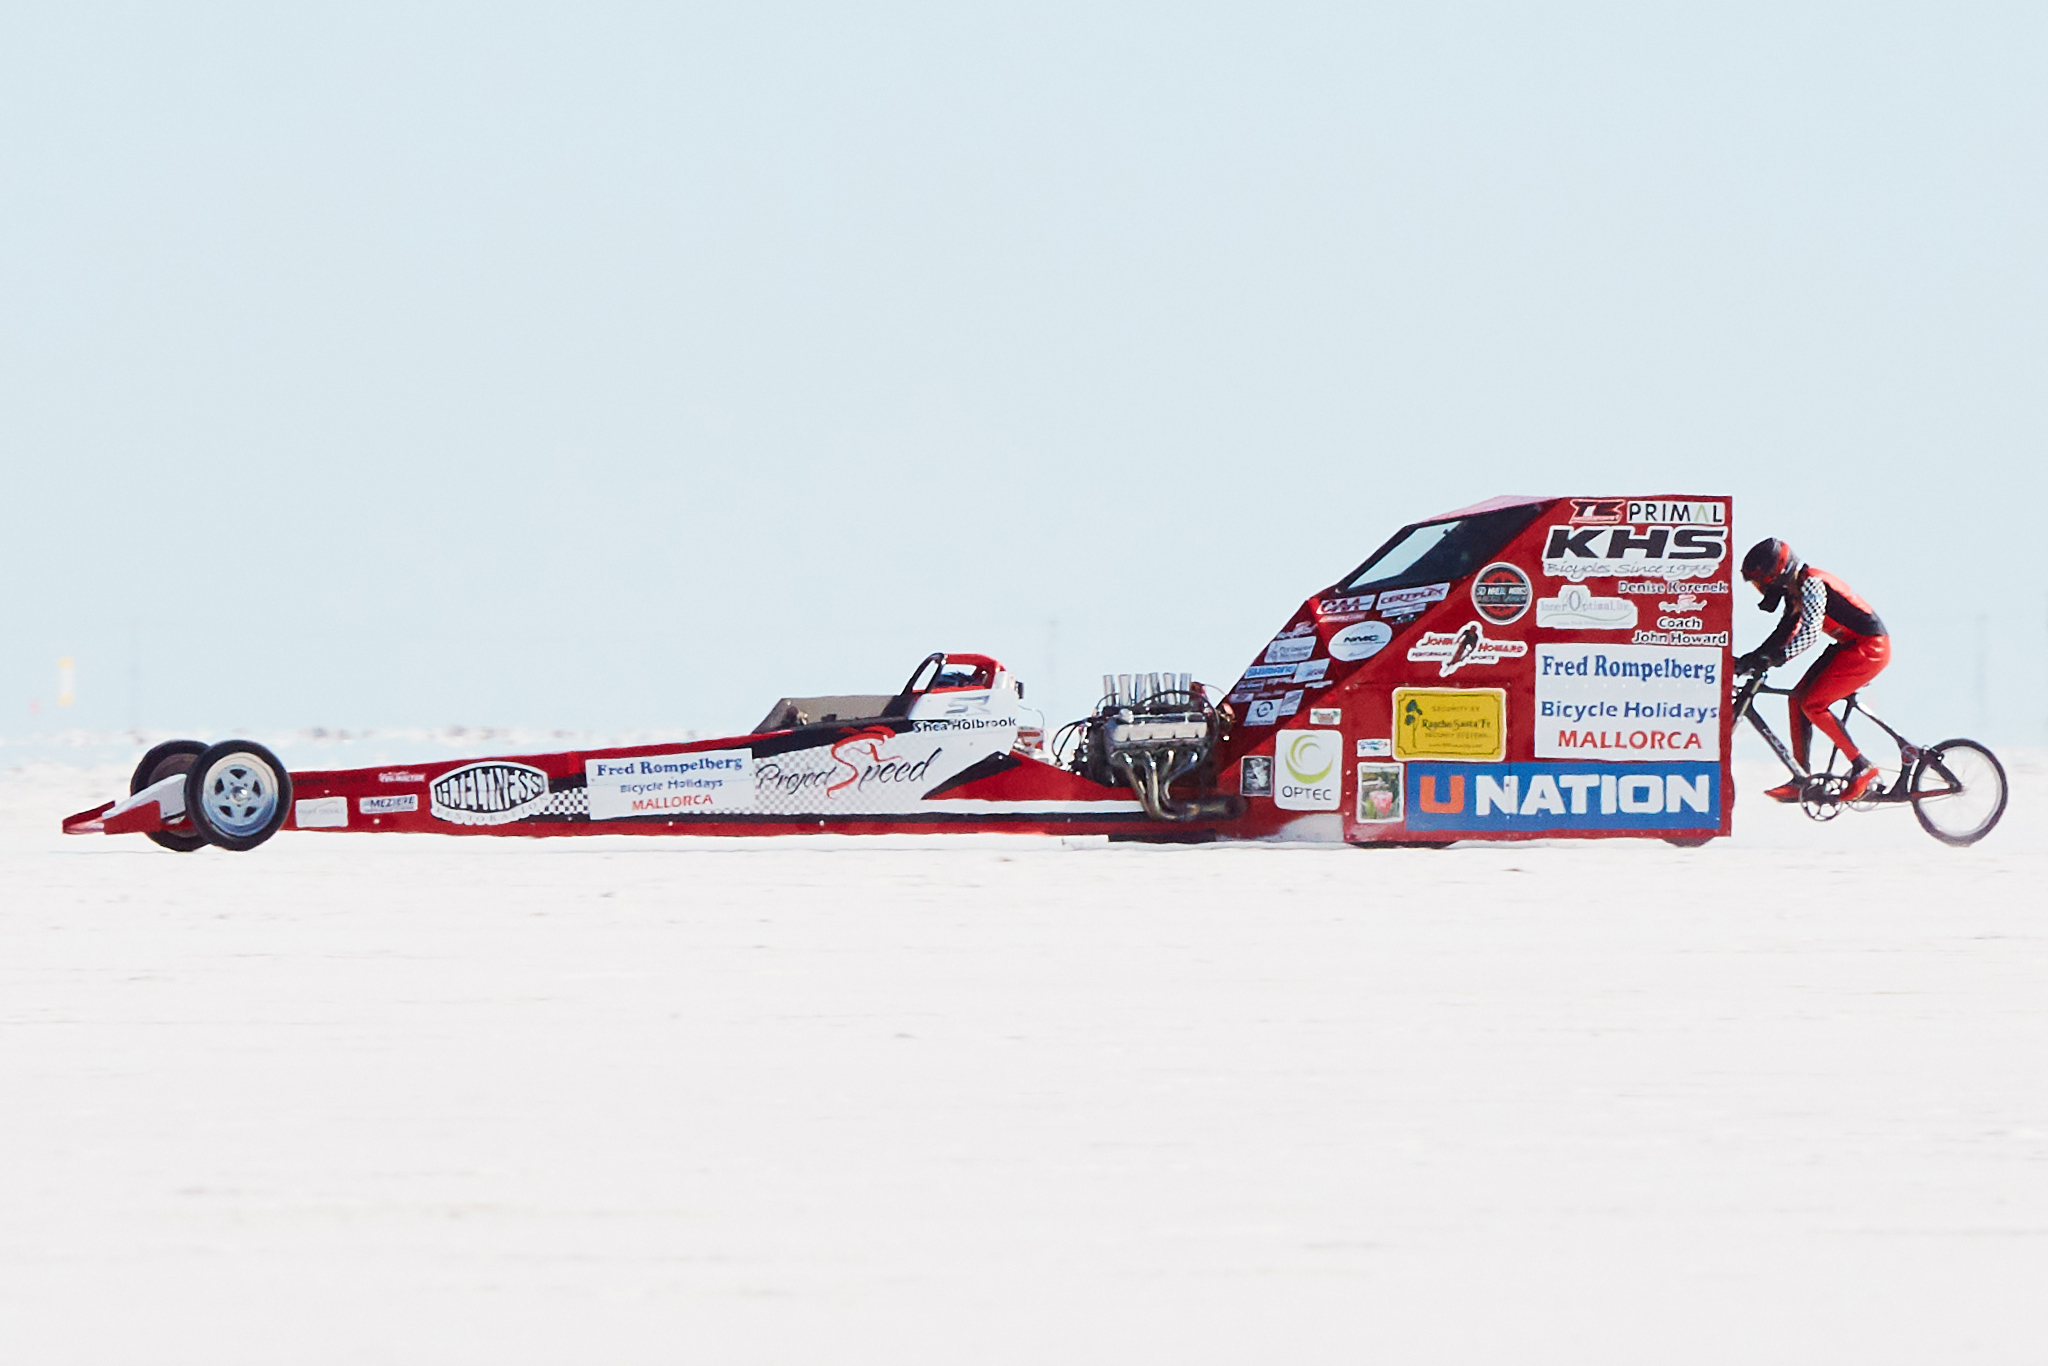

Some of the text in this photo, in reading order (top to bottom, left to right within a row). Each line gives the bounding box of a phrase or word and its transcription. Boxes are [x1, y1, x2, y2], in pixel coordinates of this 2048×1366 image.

[1629, 503, 1723, 523] PRIMAL
[1545, 529, 1725, 559] KHS
[1546, 561, 1714, 580] Bicycles Since 1975
[1619, 582, 1728, 593] Denise Korenek
[1659, 618, 1701, 628] Coach
[1634, 632, 1727, 644] John Howard
[1542, 655, 1716, 684] Fred Rompelberg
[1541, 701, 1718, 723] Bicycle Holidays
[913, 717, 1017, 734] Shea Holbrook
[1558, 730, 1702, 749] MALLORCA
[597, 758, 743, 777] Fred Rompelberg
[755, 727, 942, 799] Project Speed
[620, 779, 723, 795] Bicycle Holidays
[1281, 785, 1332, 801] OPTEC
[1419, 774, 1710, 815] U NATION
[632, 794, 714, 811] MALLORCA
